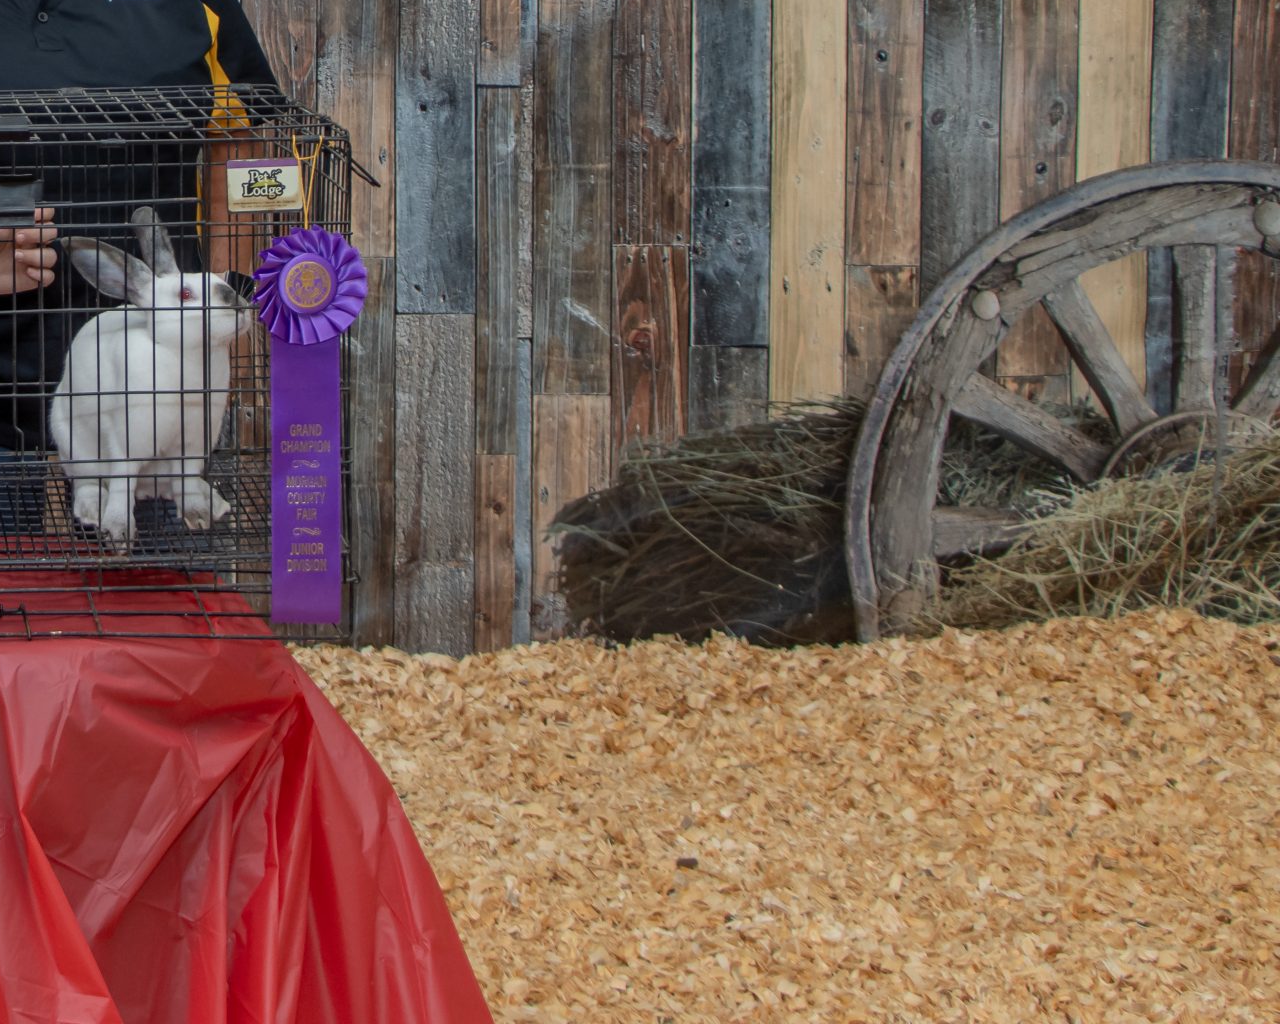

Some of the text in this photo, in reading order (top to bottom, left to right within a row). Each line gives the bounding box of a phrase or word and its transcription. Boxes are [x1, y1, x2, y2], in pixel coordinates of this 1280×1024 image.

[249, 169, 269, 183] Pet
[242, 183, 283, 199] Lodge
[289, 424, 323, 437] GRAND
[280, 440, 331, 453] CHAMPION
[286, 475, 327, 488] MORGAN
[287, 492, 326, 505] COUNTY
[296, 508, 318, 520] FAIR
[289, 543, 324, 556] JUNIOR
[286, 559, 327, 572] DIVISION
